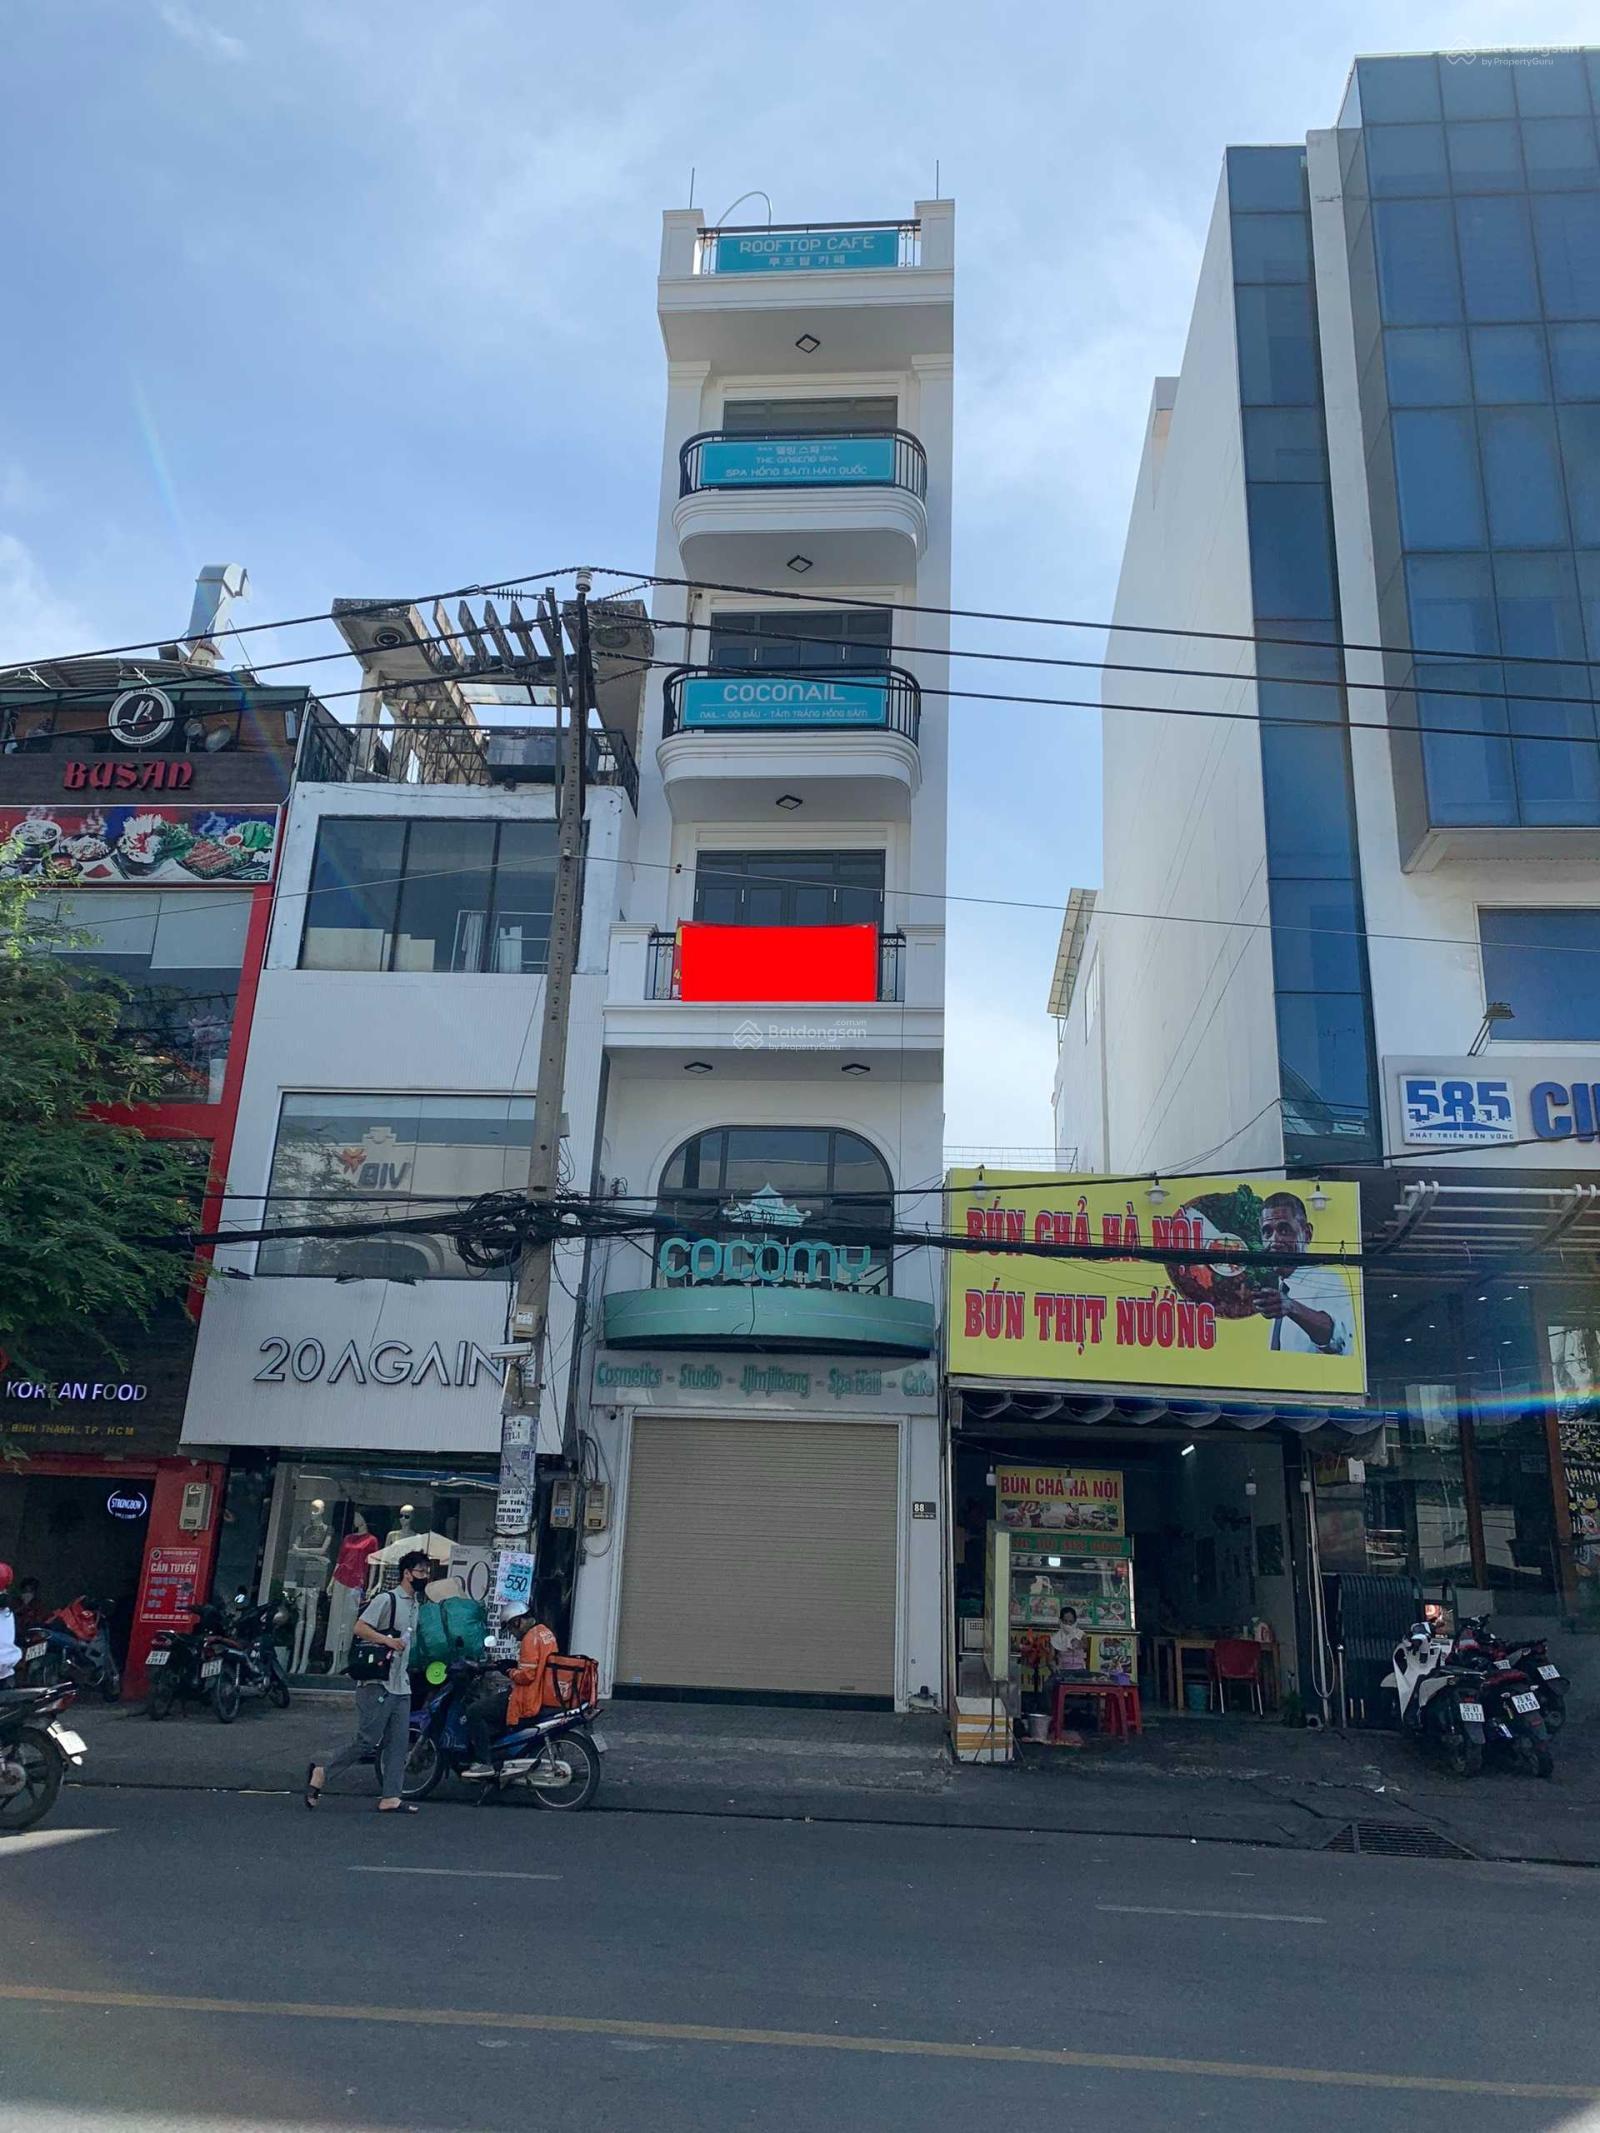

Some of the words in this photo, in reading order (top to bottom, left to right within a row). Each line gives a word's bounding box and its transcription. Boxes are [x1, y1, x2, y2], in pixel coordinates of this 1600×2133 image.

[739, 238, 821, 254] ROOFTOP
[827, 236, 875, 250] CAFE
[725, 468, 748, 477] SPA
[62, 760, 193, 792] BUSAN
[1405, 1080, 1512, 1122] 585
[1530, 1081, 1600, 1143] CI
[966, 1196, 1026, 1256] BÚN
[1034, 1196, 1092, 1260] CHẢ
[1102, 1201, 1142, 1264] HÀ
[659, 1237, 872, 1283] COCOMY
[964, 1278, 1026, 1340] BÚN
[1034, 1292, 1107, 1356] THỊT
[1116, 1285, 1217, 1350] NƯỚNG
[6, 1380, 88, 1400] KOREAN
[91, 1382, 147, 1401] FOOD
[679, 1363, 722, 1390] Studio
[107, 1426, 135, 1436] HCM
[1001, 1474, 1031, 1495] BÚN
[1035, 1474, 1064, 1496] CHẢ
[1093, 1478, 1118, 1503] NỘI
[504, 1574, 528, 1592] 550
